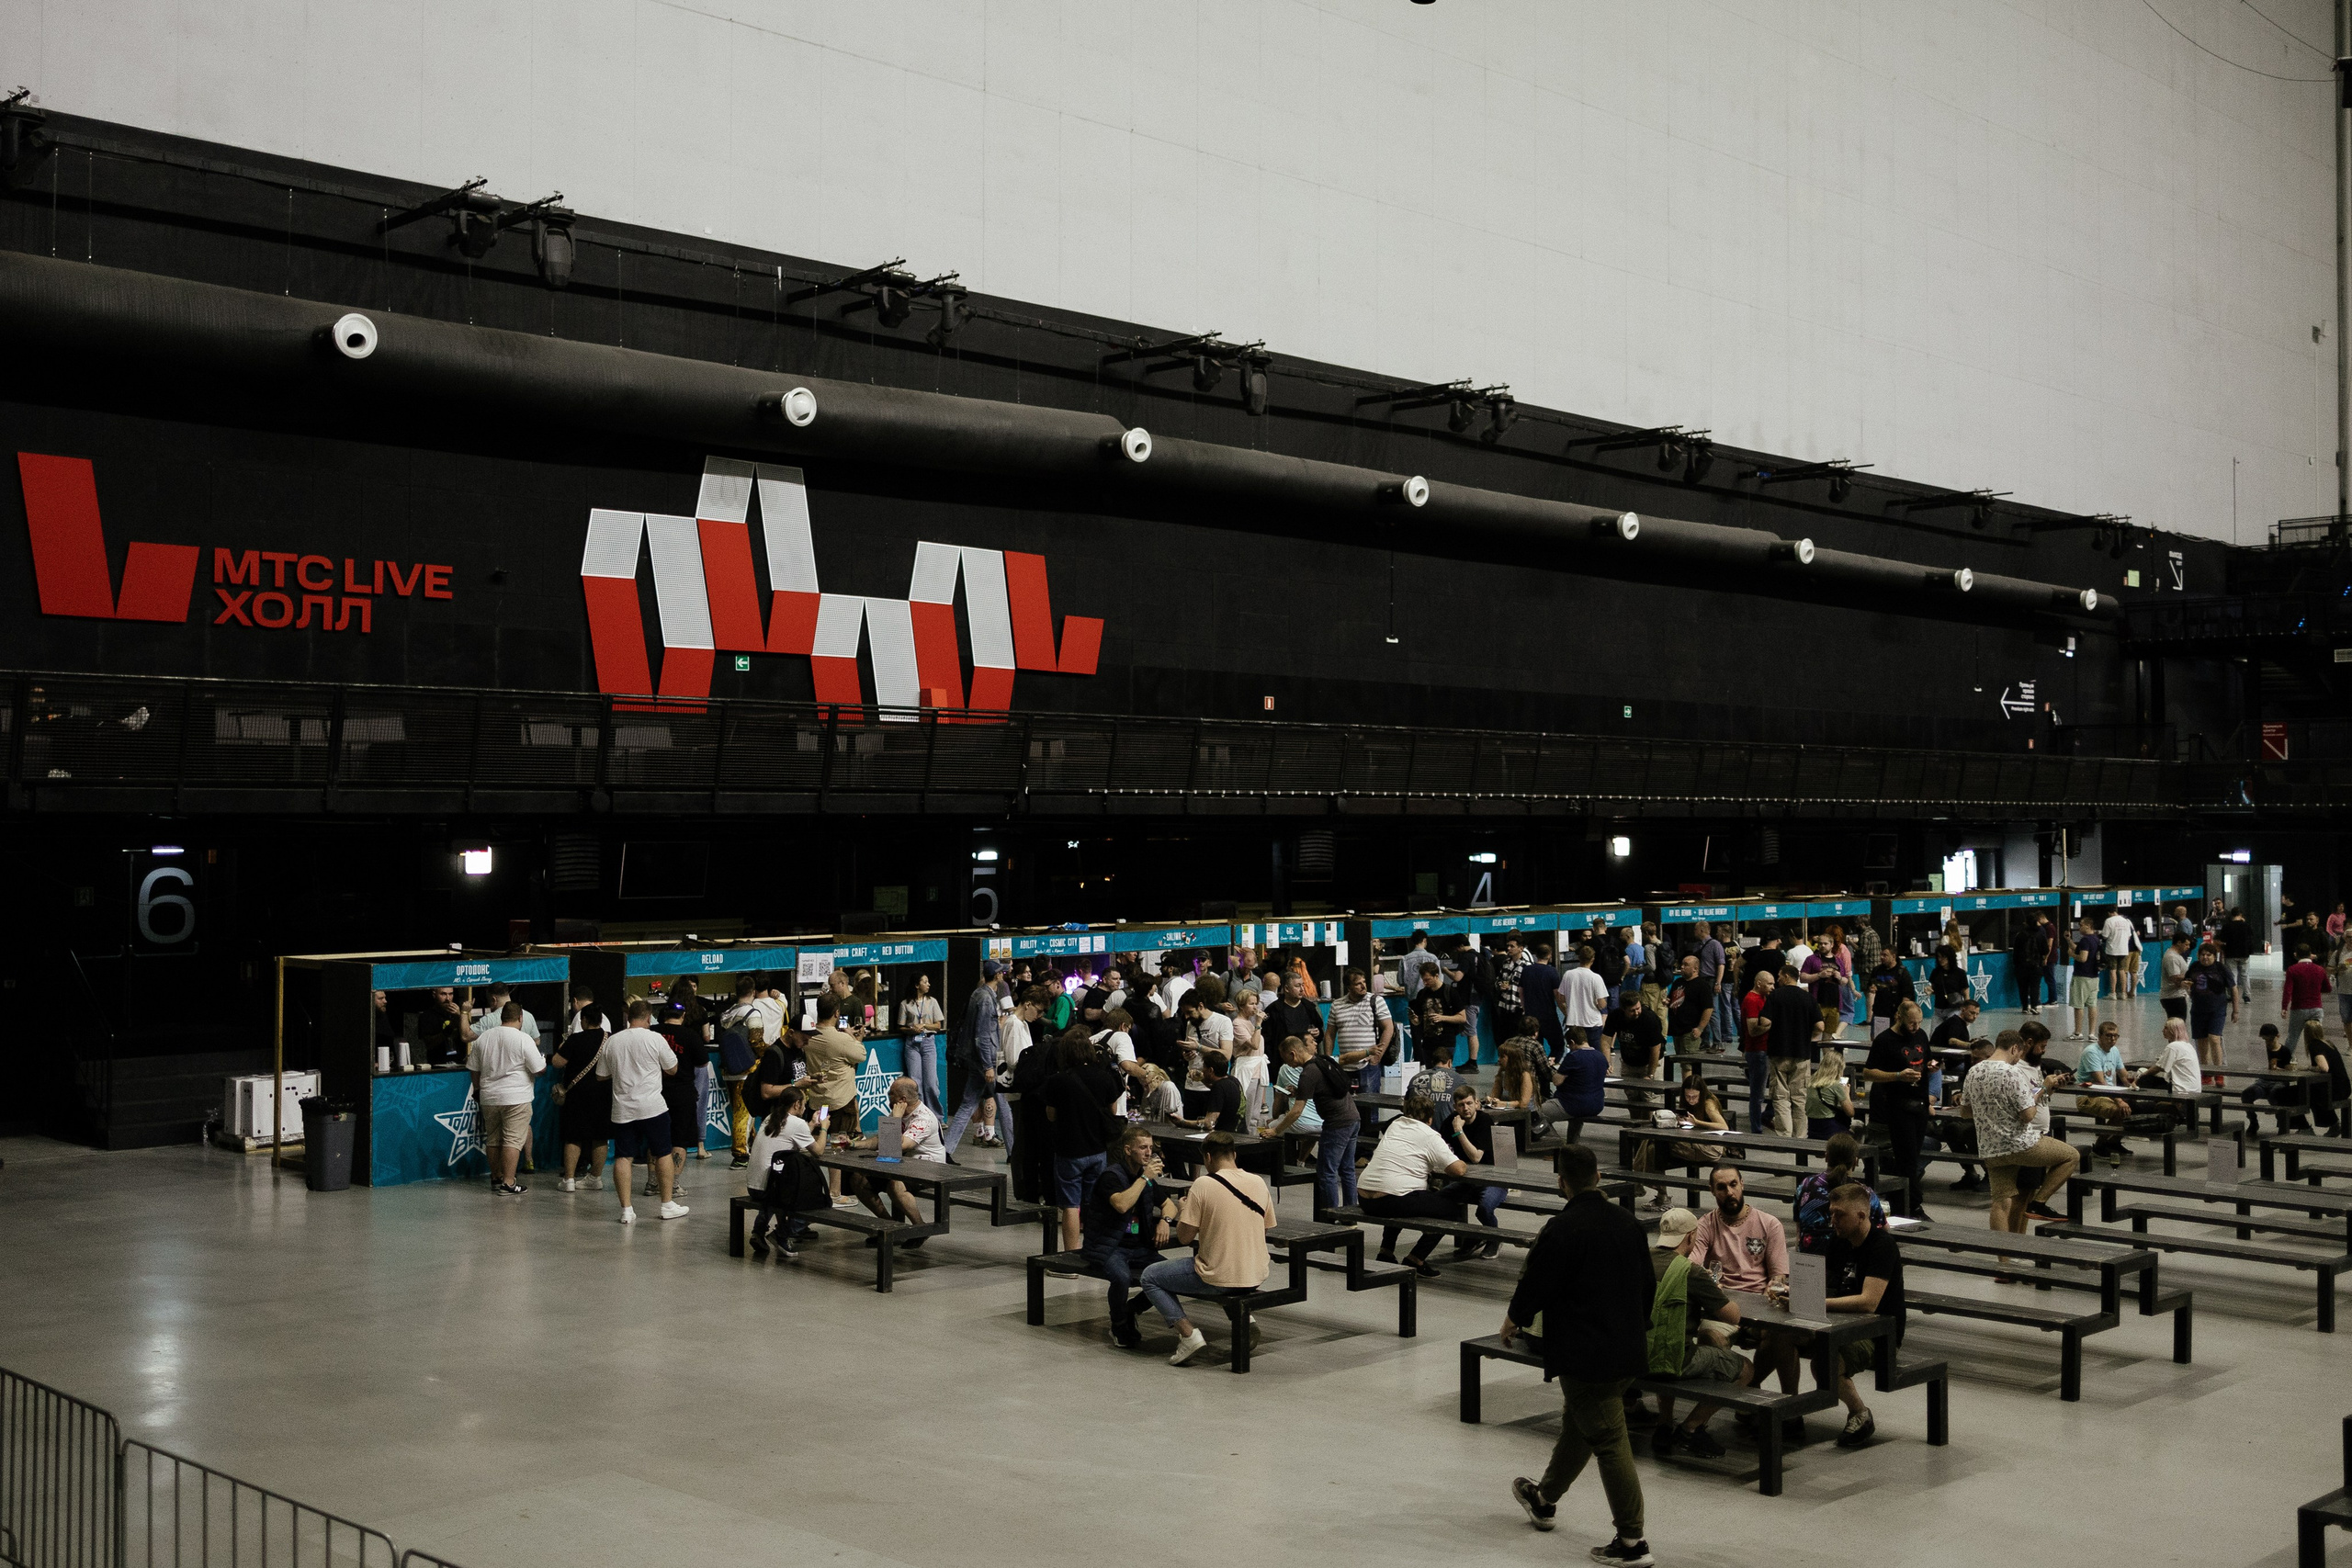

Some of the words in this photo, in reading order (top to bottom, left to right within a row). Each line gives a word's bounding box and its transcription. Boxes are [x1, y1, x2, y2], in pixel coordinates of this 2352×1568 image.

[214, 547, 334, 591] МТС
[345, 558, 453, 600] LIVE
[214, 589, 372, 633] ХОЛЛ
[1471, 873, 1496, 908] 4
[138, 867, 195, 943] 6
[1049, 938, 1066, 947] COSMIC
[1068, 937, 1078, 946] CITY
[701, 953, 724, 964] RELOAD
[852, 947, 867, 957] CRAFT
[882, 946, 892, 956] RED
[895, 945, 913, 955] BUTTON
[456, 964, 490, 976] ОРТОДОКС
[867, 1065, 879, 1075] FEST
[859, 1096, 891, 1117] BEER
